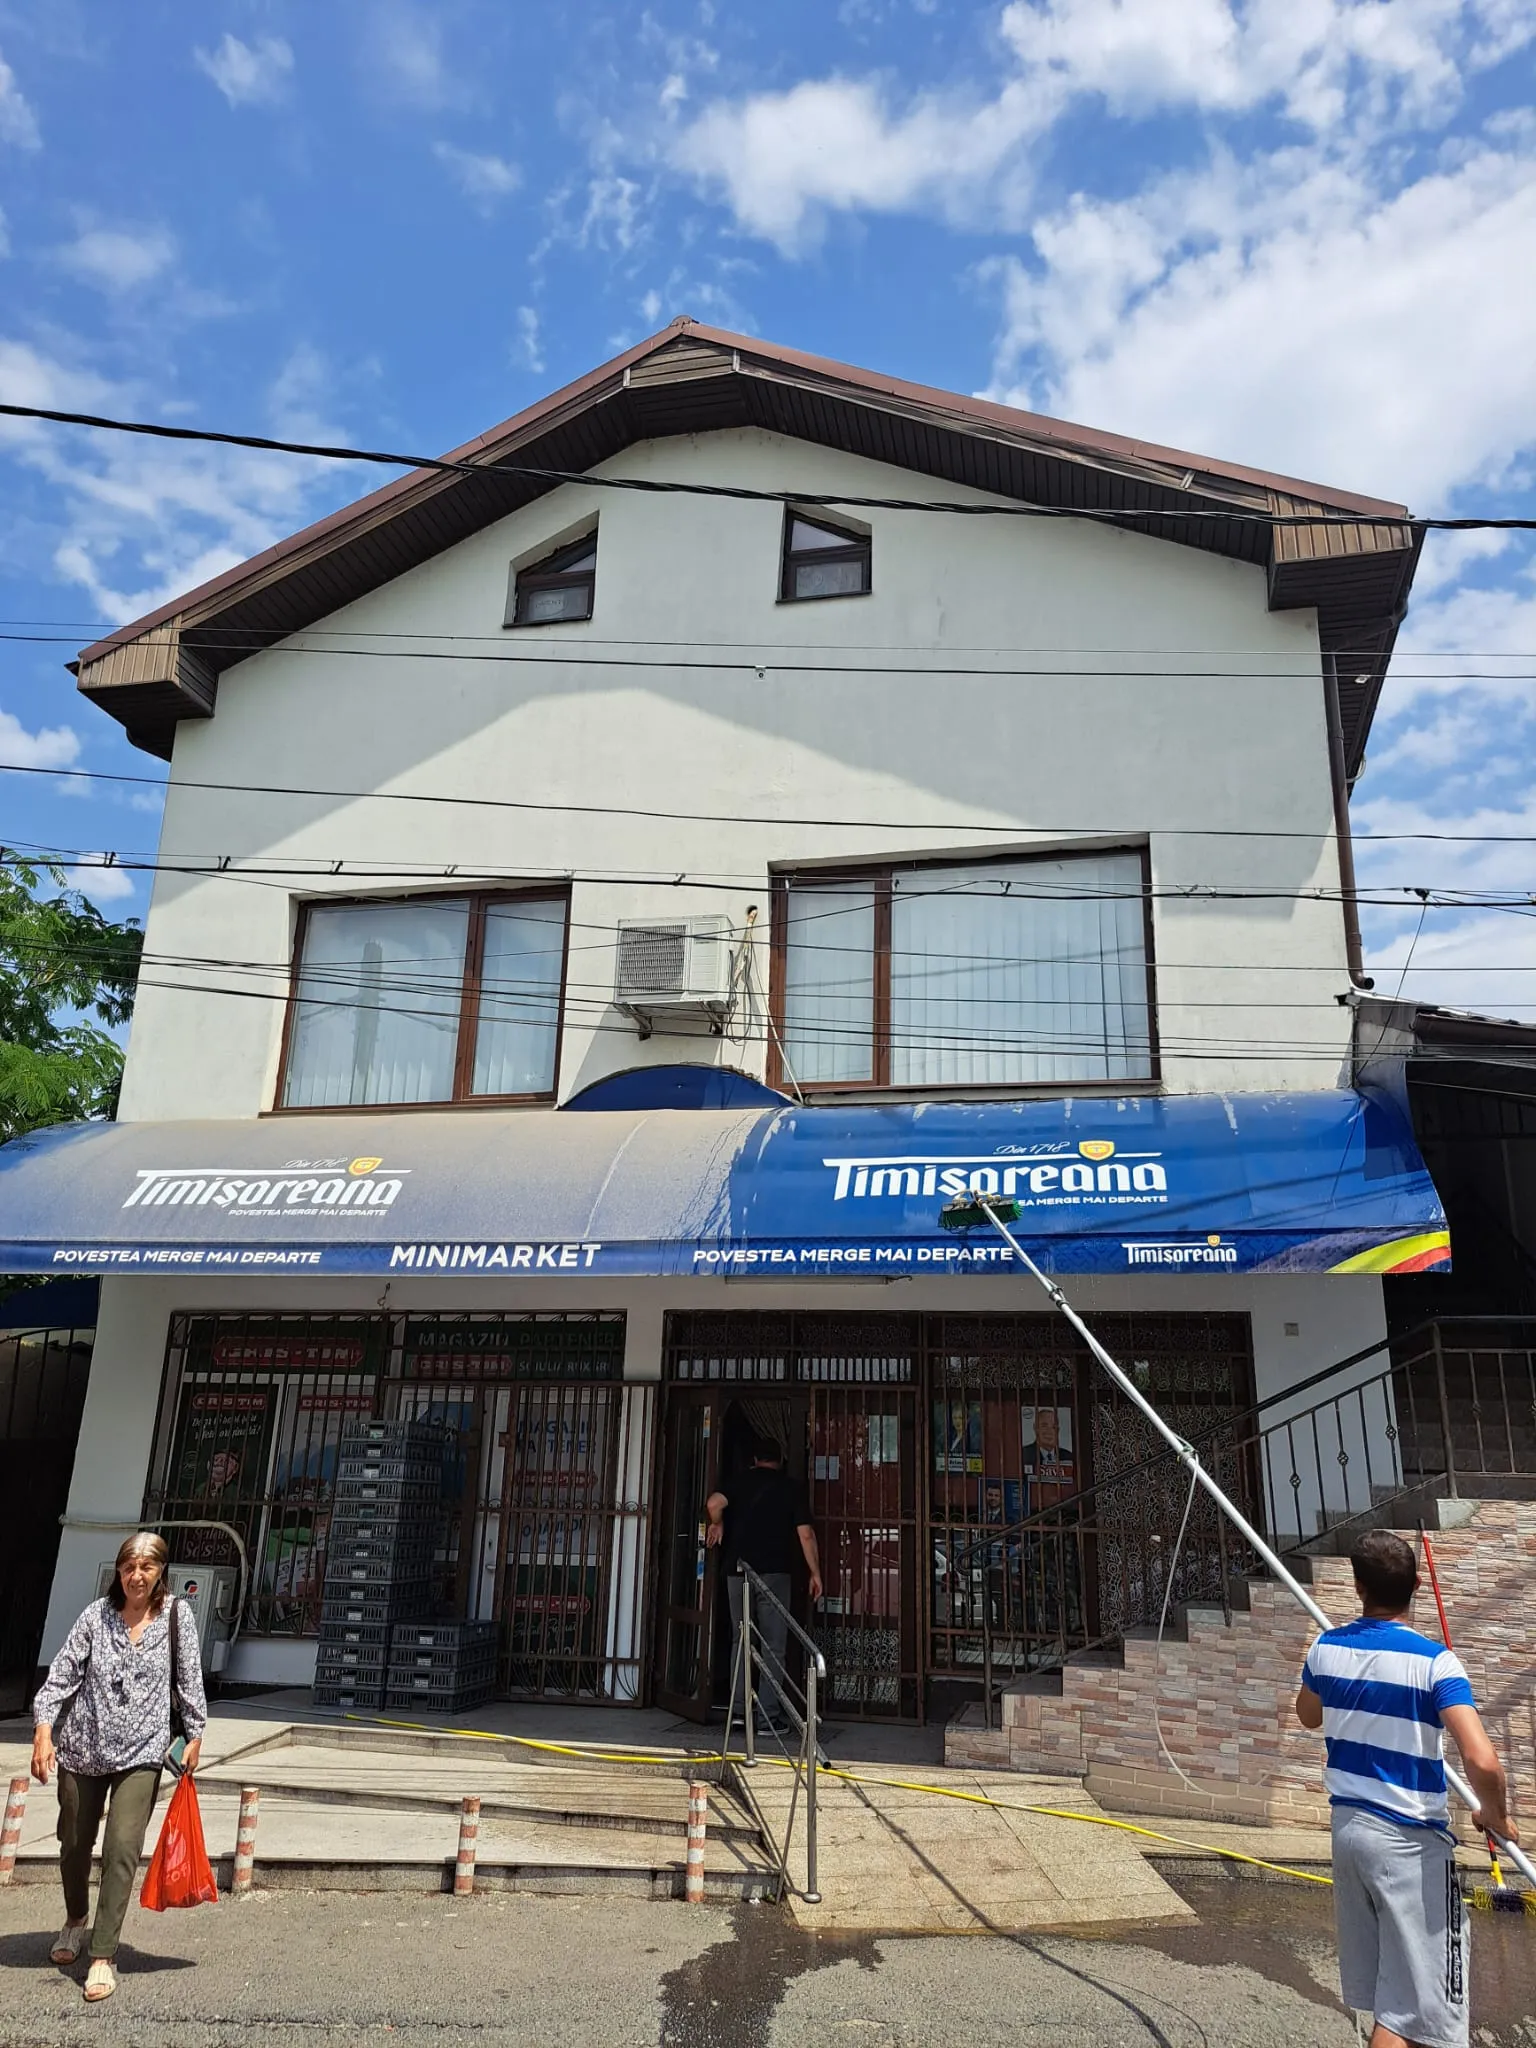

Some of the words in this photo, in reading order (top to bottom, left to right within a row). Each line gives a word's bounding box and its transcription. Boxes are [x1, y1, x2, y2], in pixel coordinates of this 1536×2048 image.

[994, 1145, 1027, 1155] Din
[1029, 1141, 1070, 1154] 1718
[1036, 1197, 1081, 1206] MERGE
[1082, 1196, 1106, 1204] MAI
[1108, 1195, 1168, 1204] DEPARTE
[281, 1208, 319, 1216] MERGE
[339, 1208, 388, 1216] DEPARTE
[53, 1250, 140, 1263] POVESTEA
[142, 1250, 205, 1264] MERGE
[205, 1251, 239, 1264] MAI
[239, 1251, 322, 1264] DEPARTE
[389, 1243, 602, 1268] MINIMARKET
[693, 1247, 797, 1263] POVESTEA
[800, 1247, 871, 1262] MERGE
[875, 1247, 912, 1262] MAI
[917, 1247, 1014, 1262] DEPARTE
